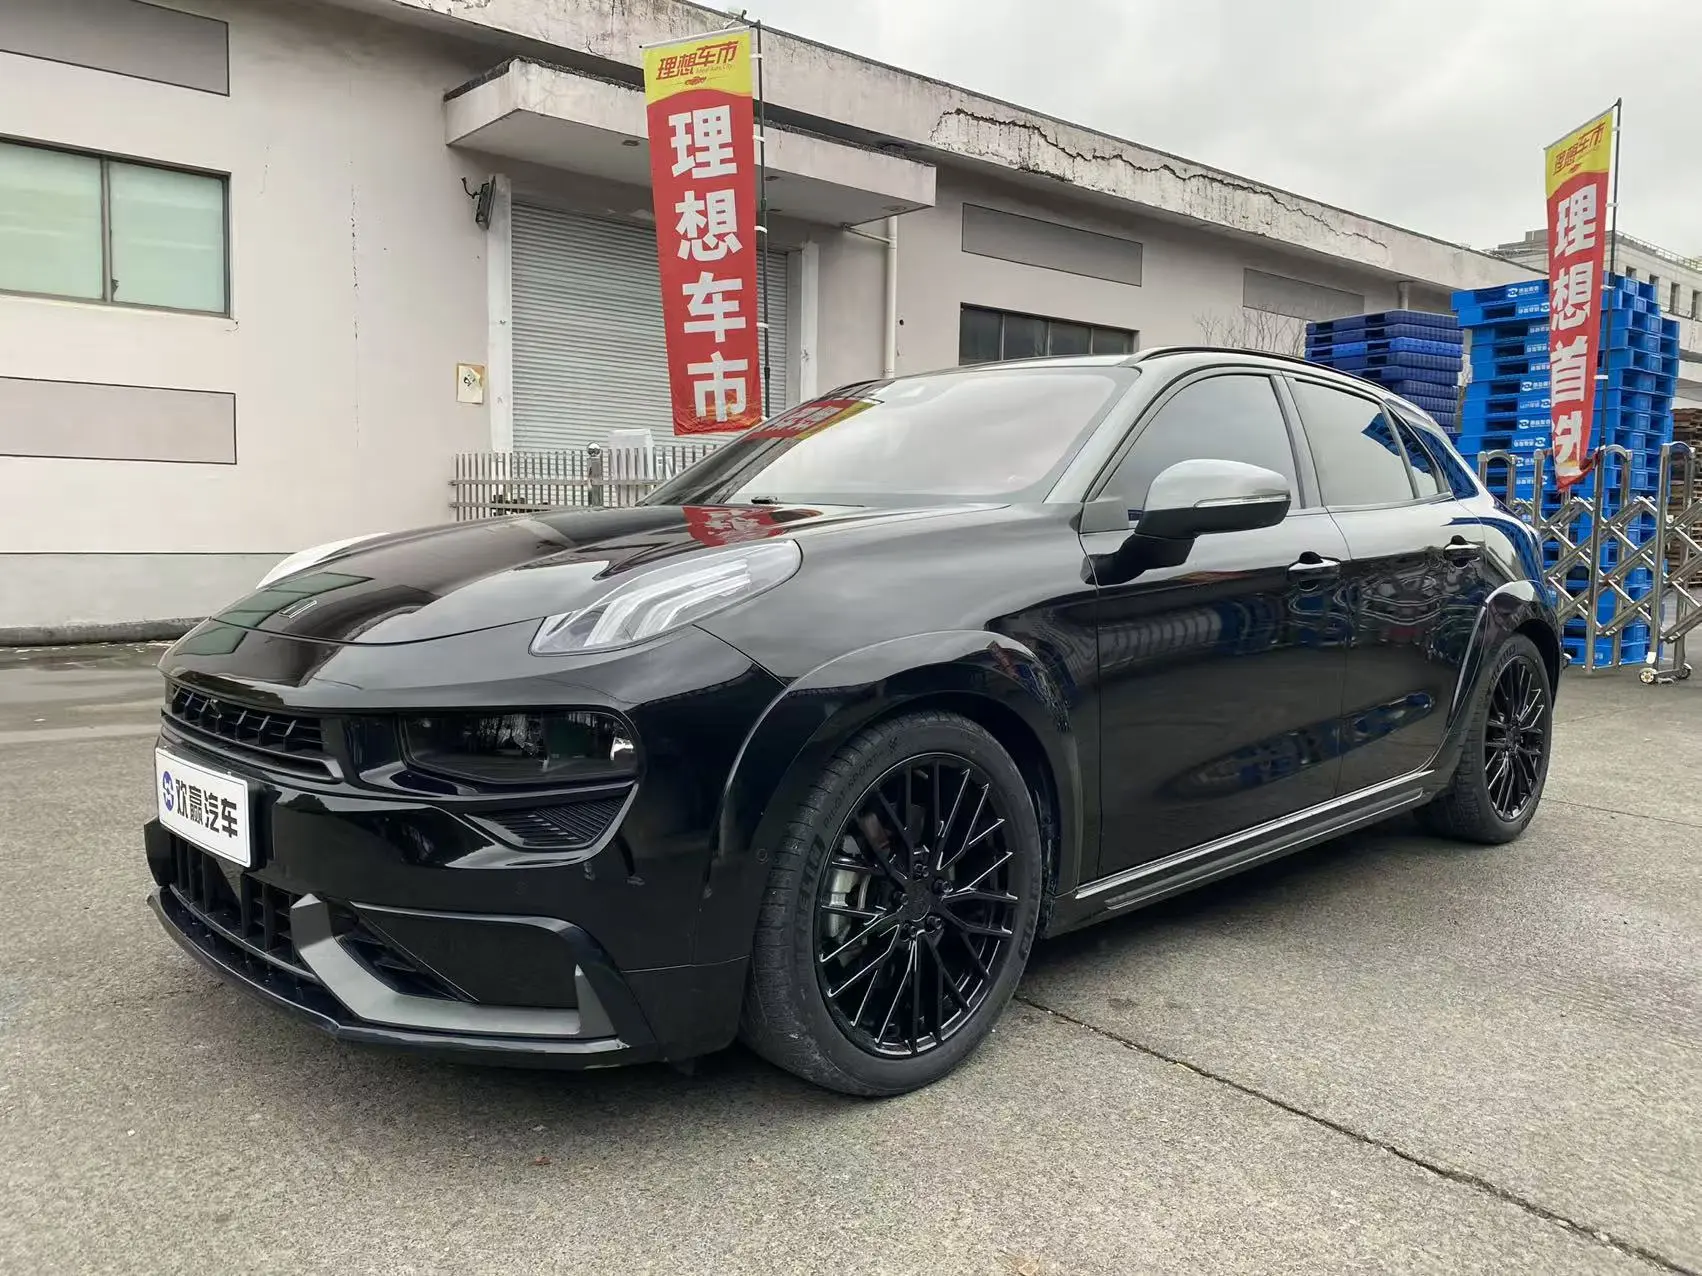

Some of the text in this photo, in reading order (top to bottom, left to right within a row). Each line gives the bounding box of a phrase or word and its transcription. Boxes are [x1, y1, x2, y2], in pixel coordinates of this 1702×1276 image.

[656, 40, 739, 81] 理想车市
[668, 104, 748, 422] 理想车市
[175, 779, 238, 838] 欢赢汽车
